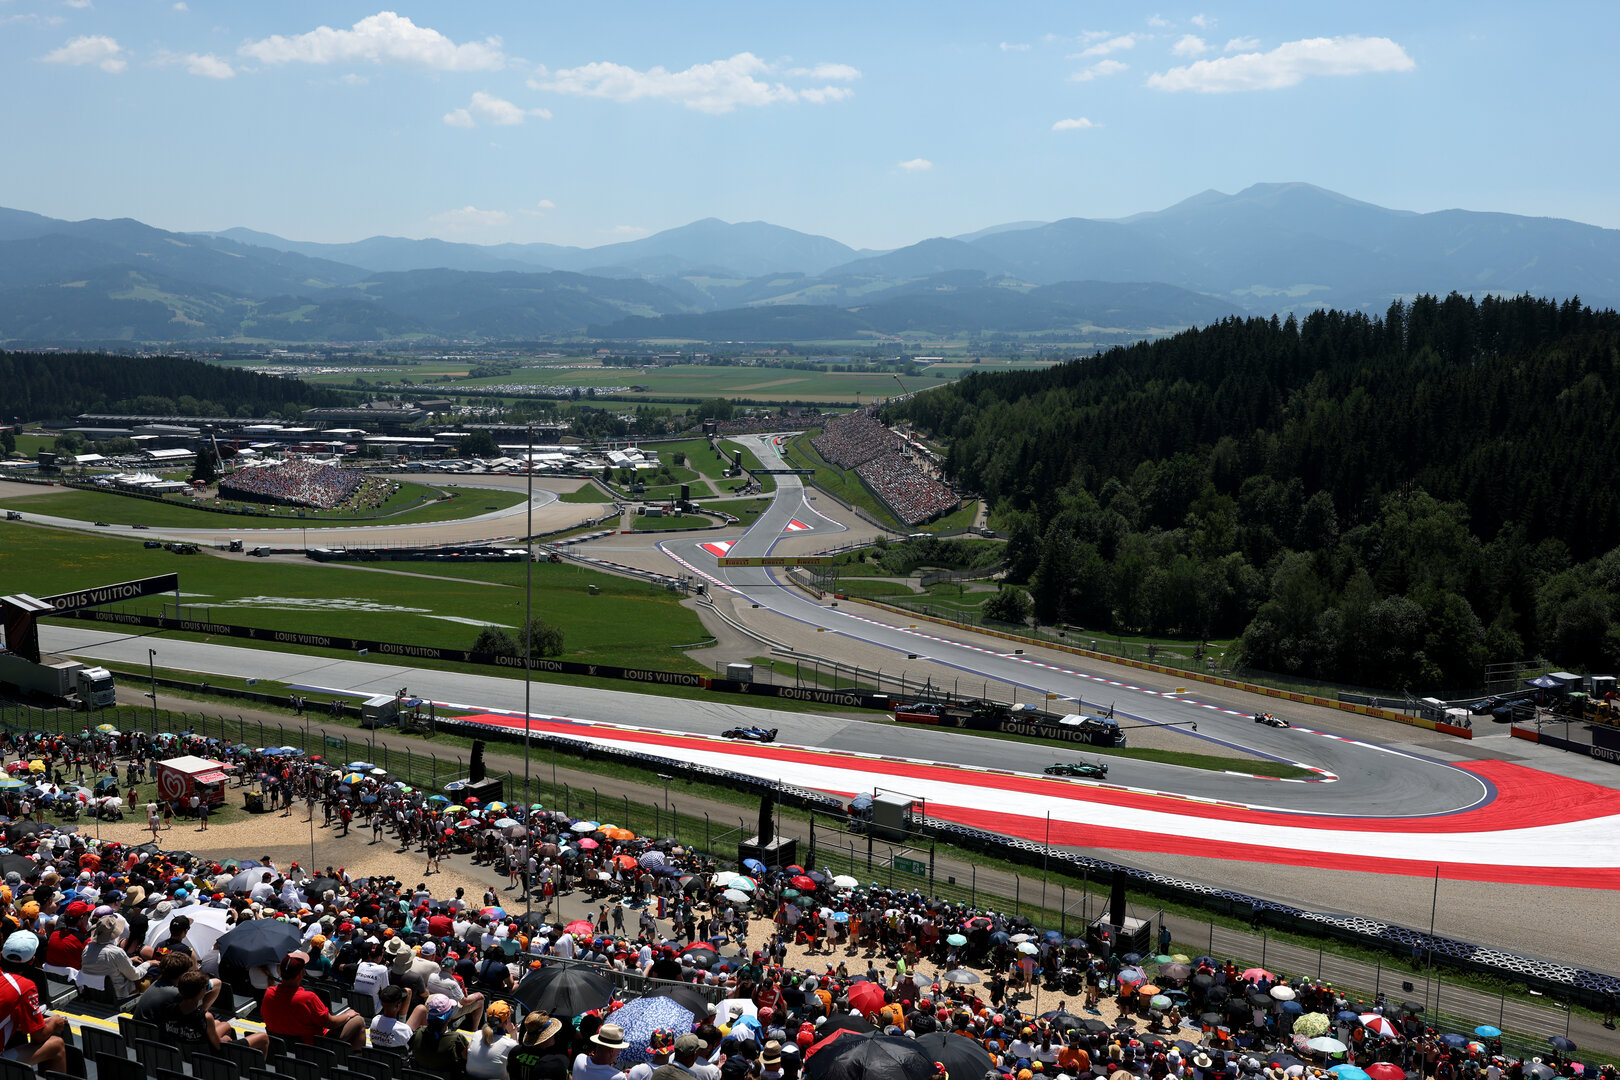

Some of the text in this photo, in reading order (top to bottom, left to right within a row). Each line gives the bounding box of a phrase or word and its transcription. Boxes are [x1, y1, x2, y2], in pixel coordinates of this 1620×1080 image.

[91, 584, 141, 603] VUITTON
[96, 612, 140, 624] LOUIS VUITTON
[181, 621, 230, 634] LOUIS VUITTON
[275, 632, 330, 646] LOUIS VUITTON
[380, 643, 440, 658] LOUIS VUITTON
[495, 655, 522, 666] LOUIS
[624, 670, 698, 685] LOUIS VUITTON
[779, 687, 862, 706] LOUIS VUITTON
[1001, 721, 1092, 743] LOUIS VUITTON
[1591, 747, 1613, 760] LOUIS
[516, 1053, 540, 1066] 46
